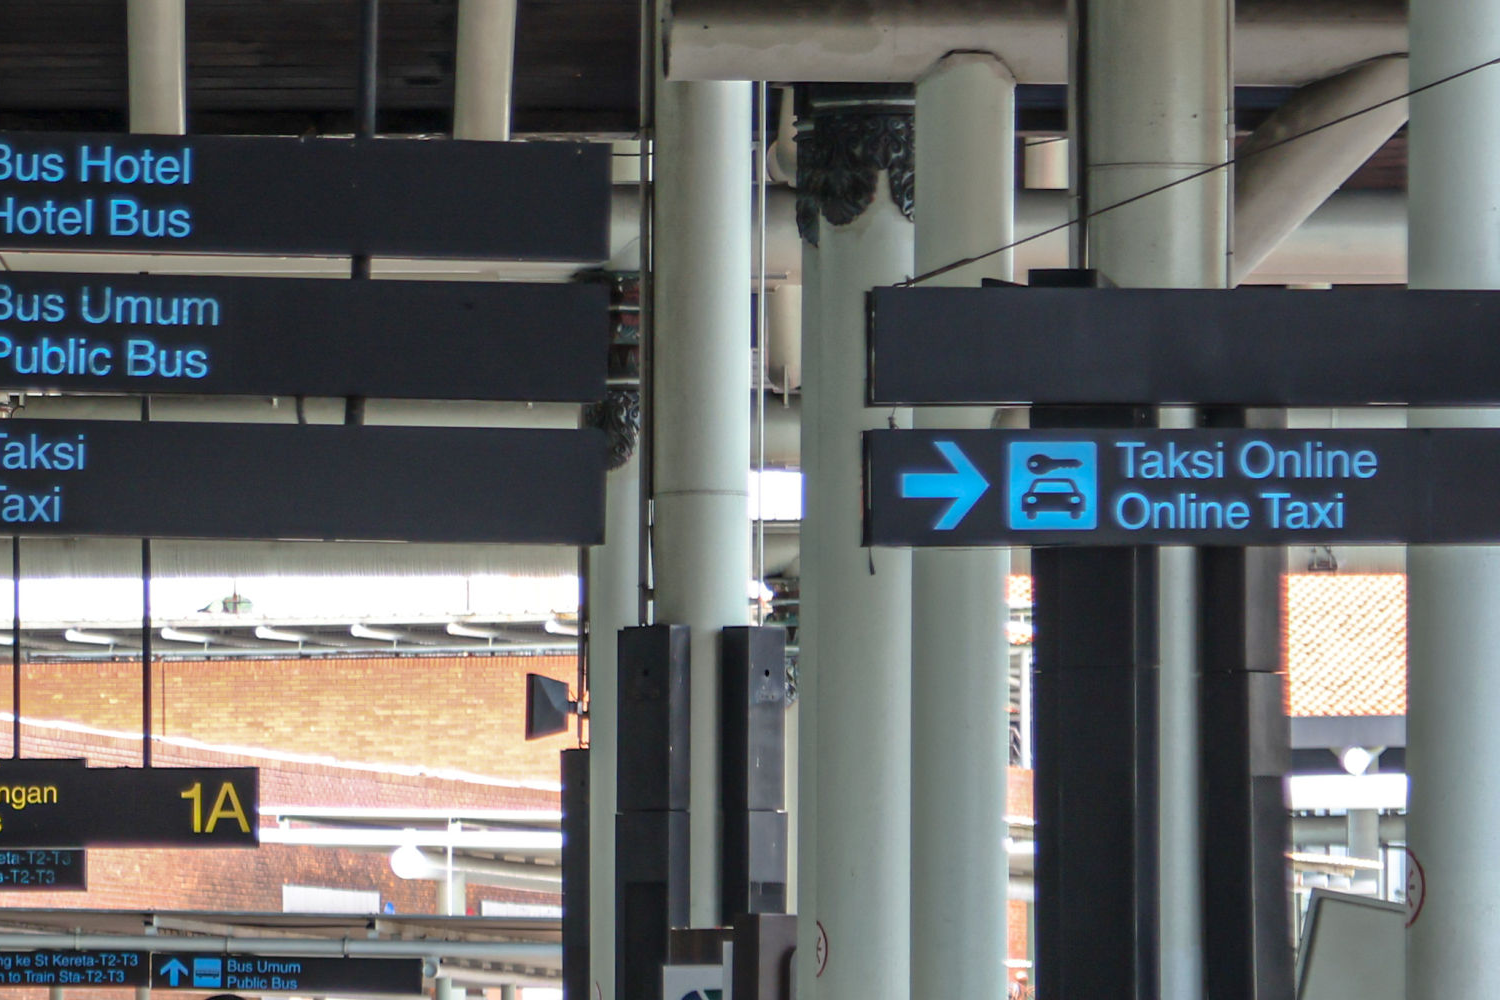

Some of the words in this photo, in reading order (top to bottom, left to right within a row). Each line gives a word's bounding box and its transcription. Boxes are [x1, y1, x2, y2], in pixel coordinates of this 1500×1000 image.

[81, 145, 191, 185] Hotel
[110, 199, 191, 238] Bus
[81, 286, 219, 327] Umum
[127, 339, 208, 379] Bus
[1116, 441, 1224, 479] Taksi
[1240, 440, 1377, 480] Online
[1116, 492, 1250, 531] Online
[1261, 492, 1344, 530] Taxi
[180, 781, 251, 834] 1A
[7, 971, 21, 983] to
[24, 971, 56, 983] Train
[58, 970, 125, 984] Sta-T2-T3
[15, 955, 32, 967] ke
[35, 955, 49, 967] St
[52, 954, 139, 967] Kereta-T2-T3
[227, 960, 254, 973] Bus
[256, 961, 301, 974] Umum
[227, 976, 268, 990] Public
[271, 977, 299, 990] Bus
